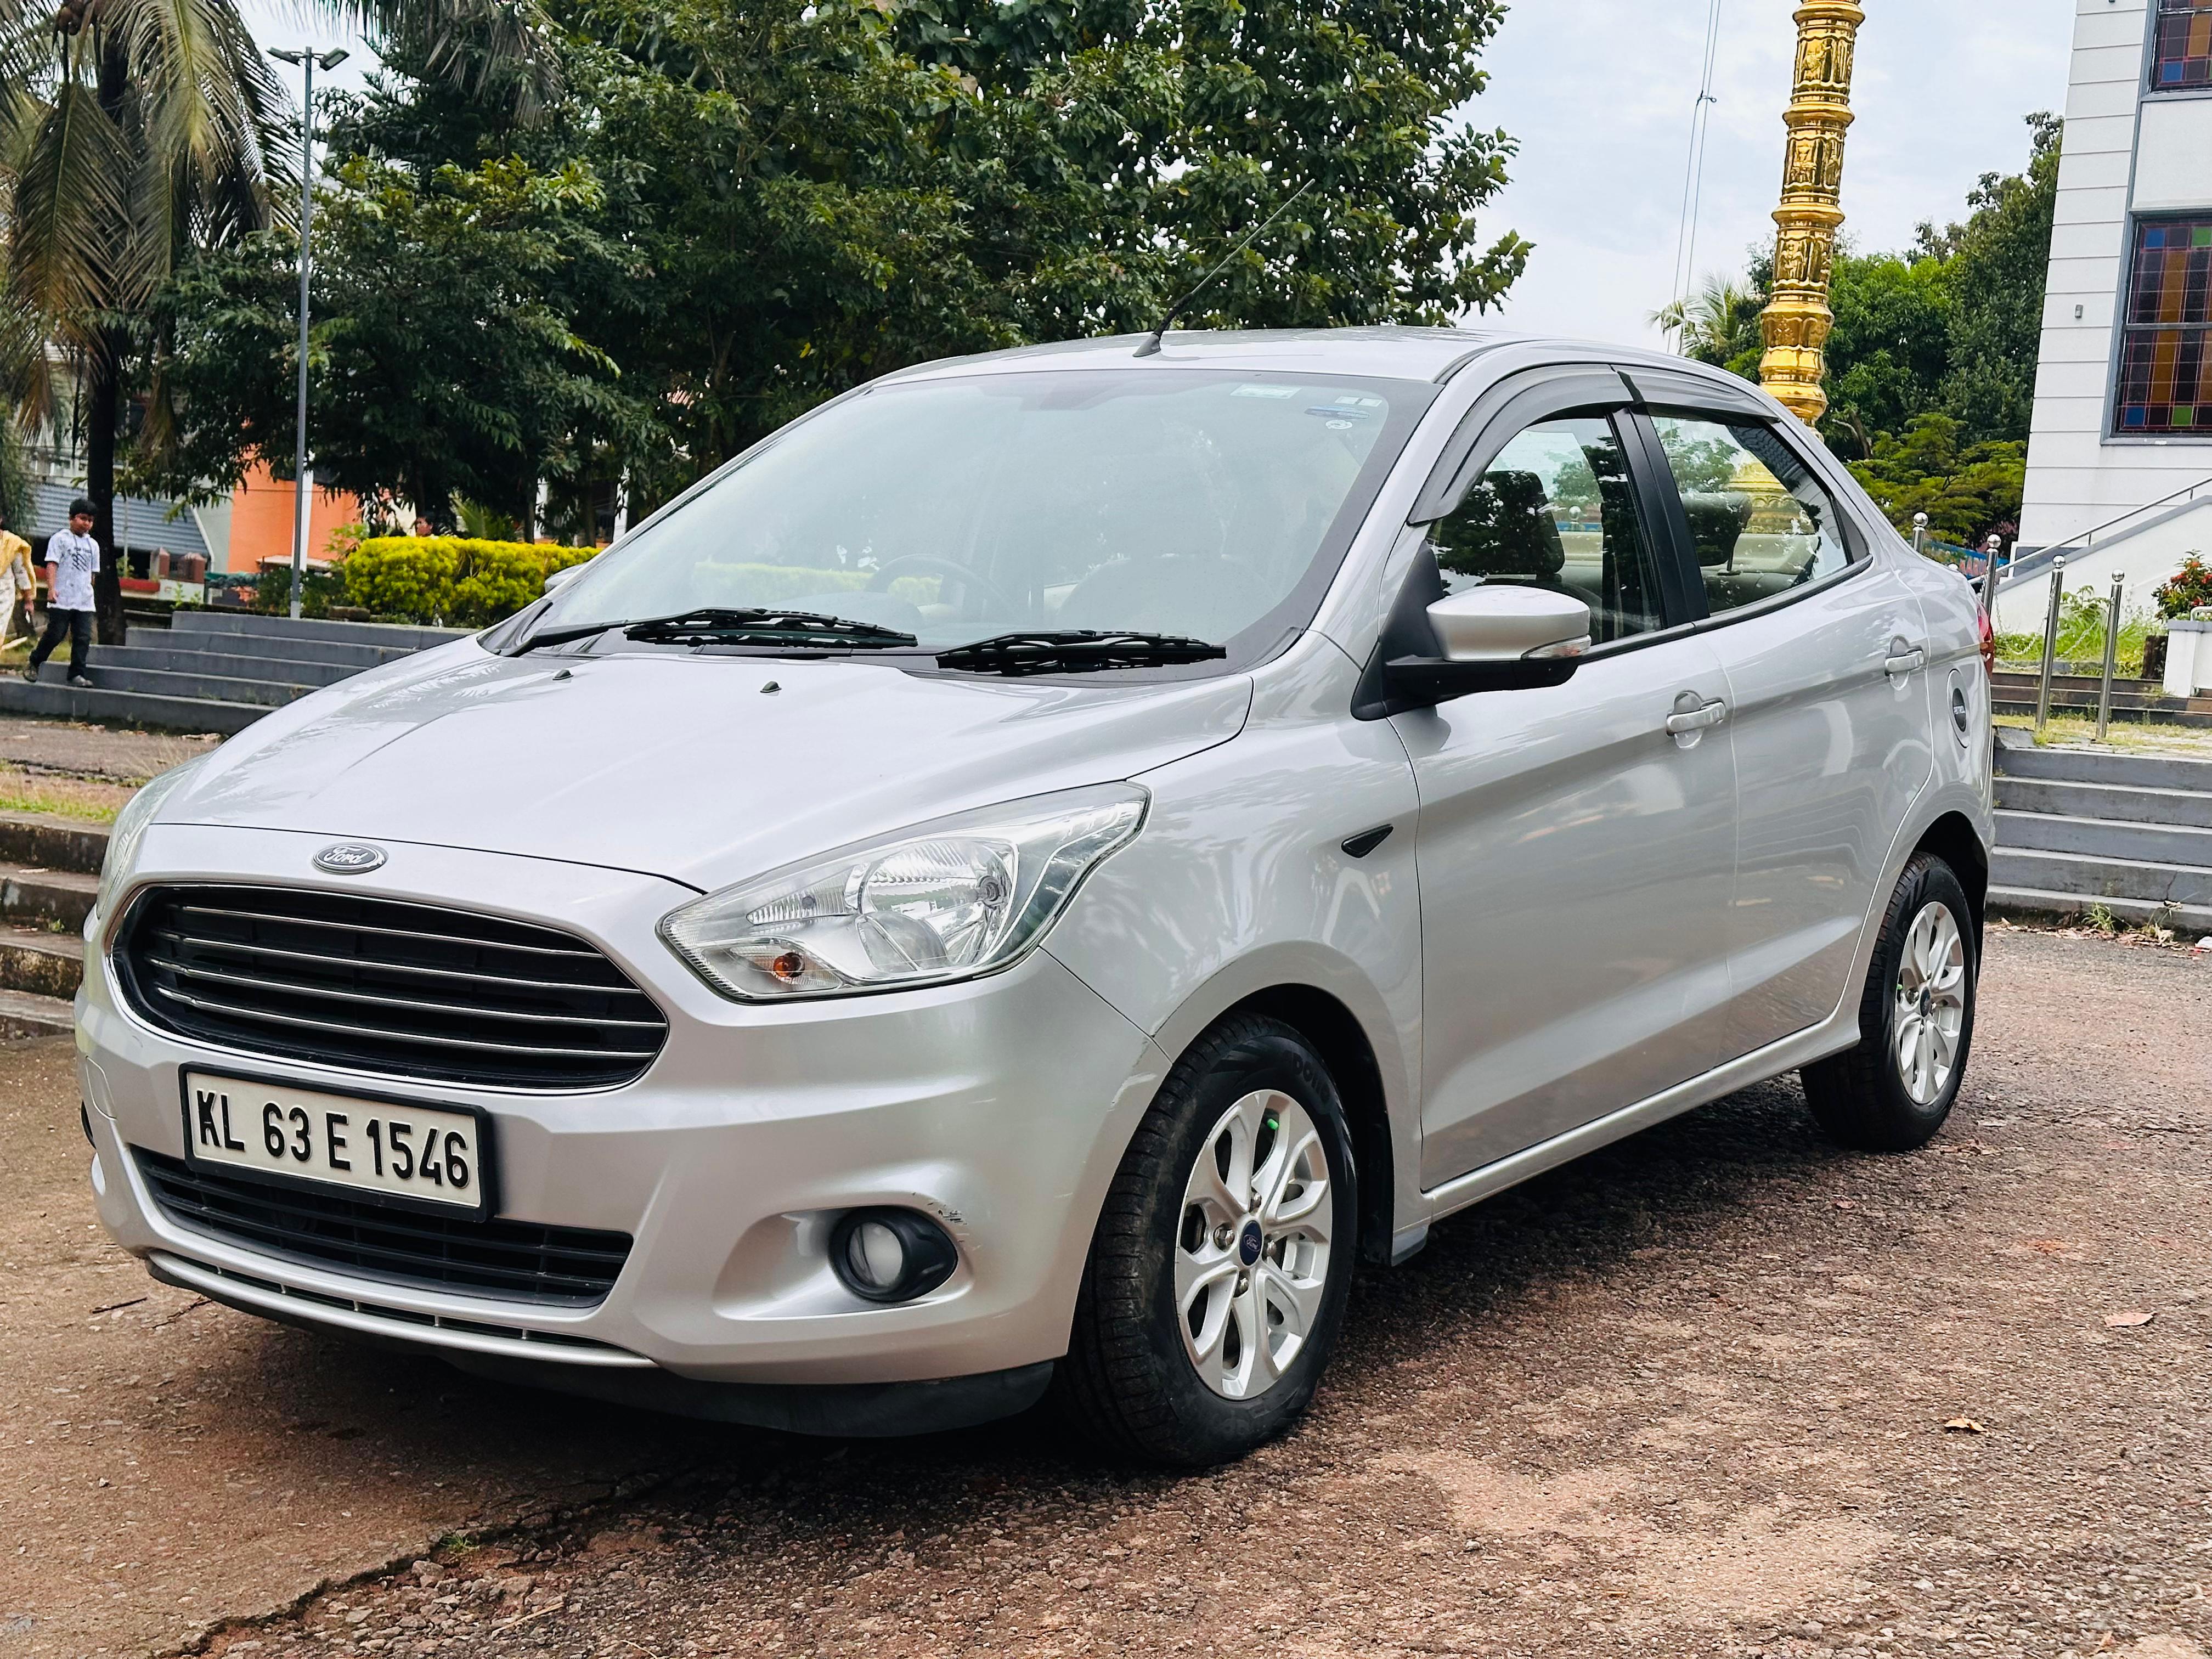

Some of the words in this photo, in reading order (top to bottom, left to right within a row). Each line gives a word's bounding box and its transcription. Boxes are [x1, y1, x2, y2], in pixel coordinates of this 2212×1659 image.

[323, 846, 368, 864] Ford
[196, 1090, 245, 1152] KL
[262, 1102, 312, 1162] 63
[326, 1111, 351, 1171] E
[366, 1118, 469, 1188] 1546
